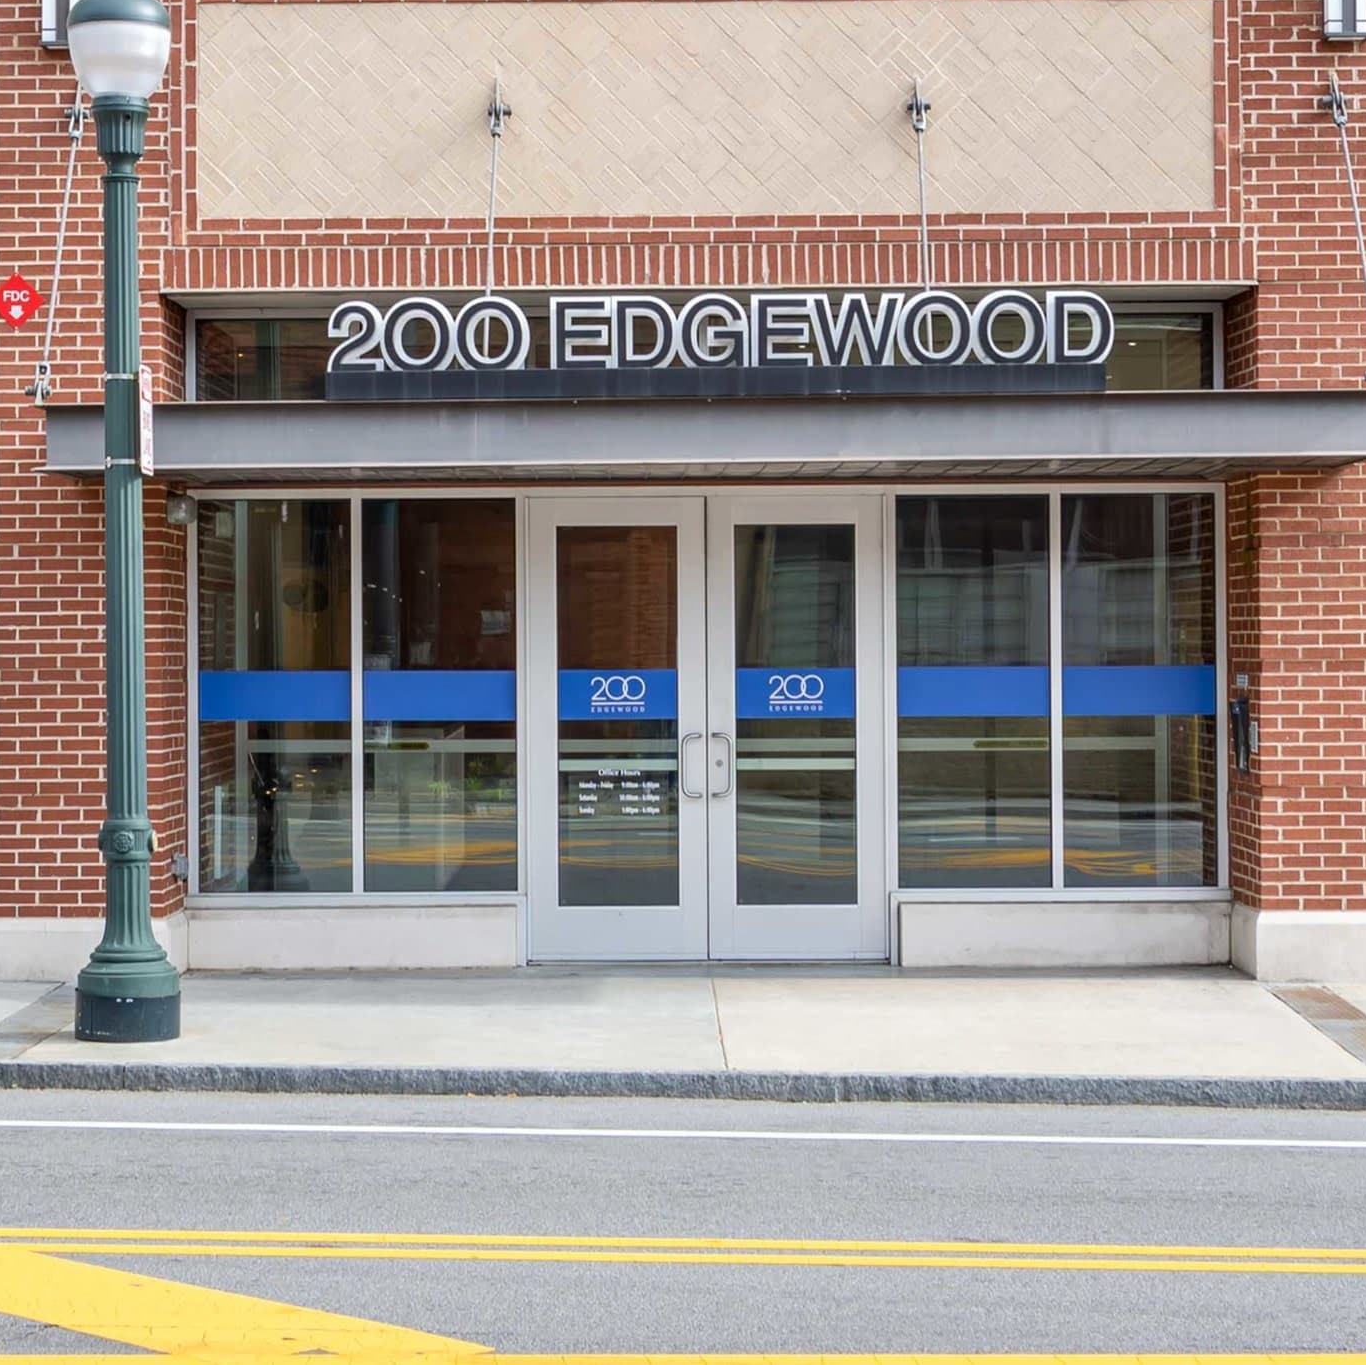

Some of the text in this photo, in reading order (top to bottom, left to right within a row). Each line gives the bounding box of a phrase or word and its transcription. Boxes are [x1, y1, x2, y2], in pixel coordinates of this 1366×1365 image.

[3, 290, 30, 302] FDC
[327, 289, 1115, 373] 200 EDGEWOOD
[590, 676, 646, 701] 200
[769, 674, 824, 700] 200
